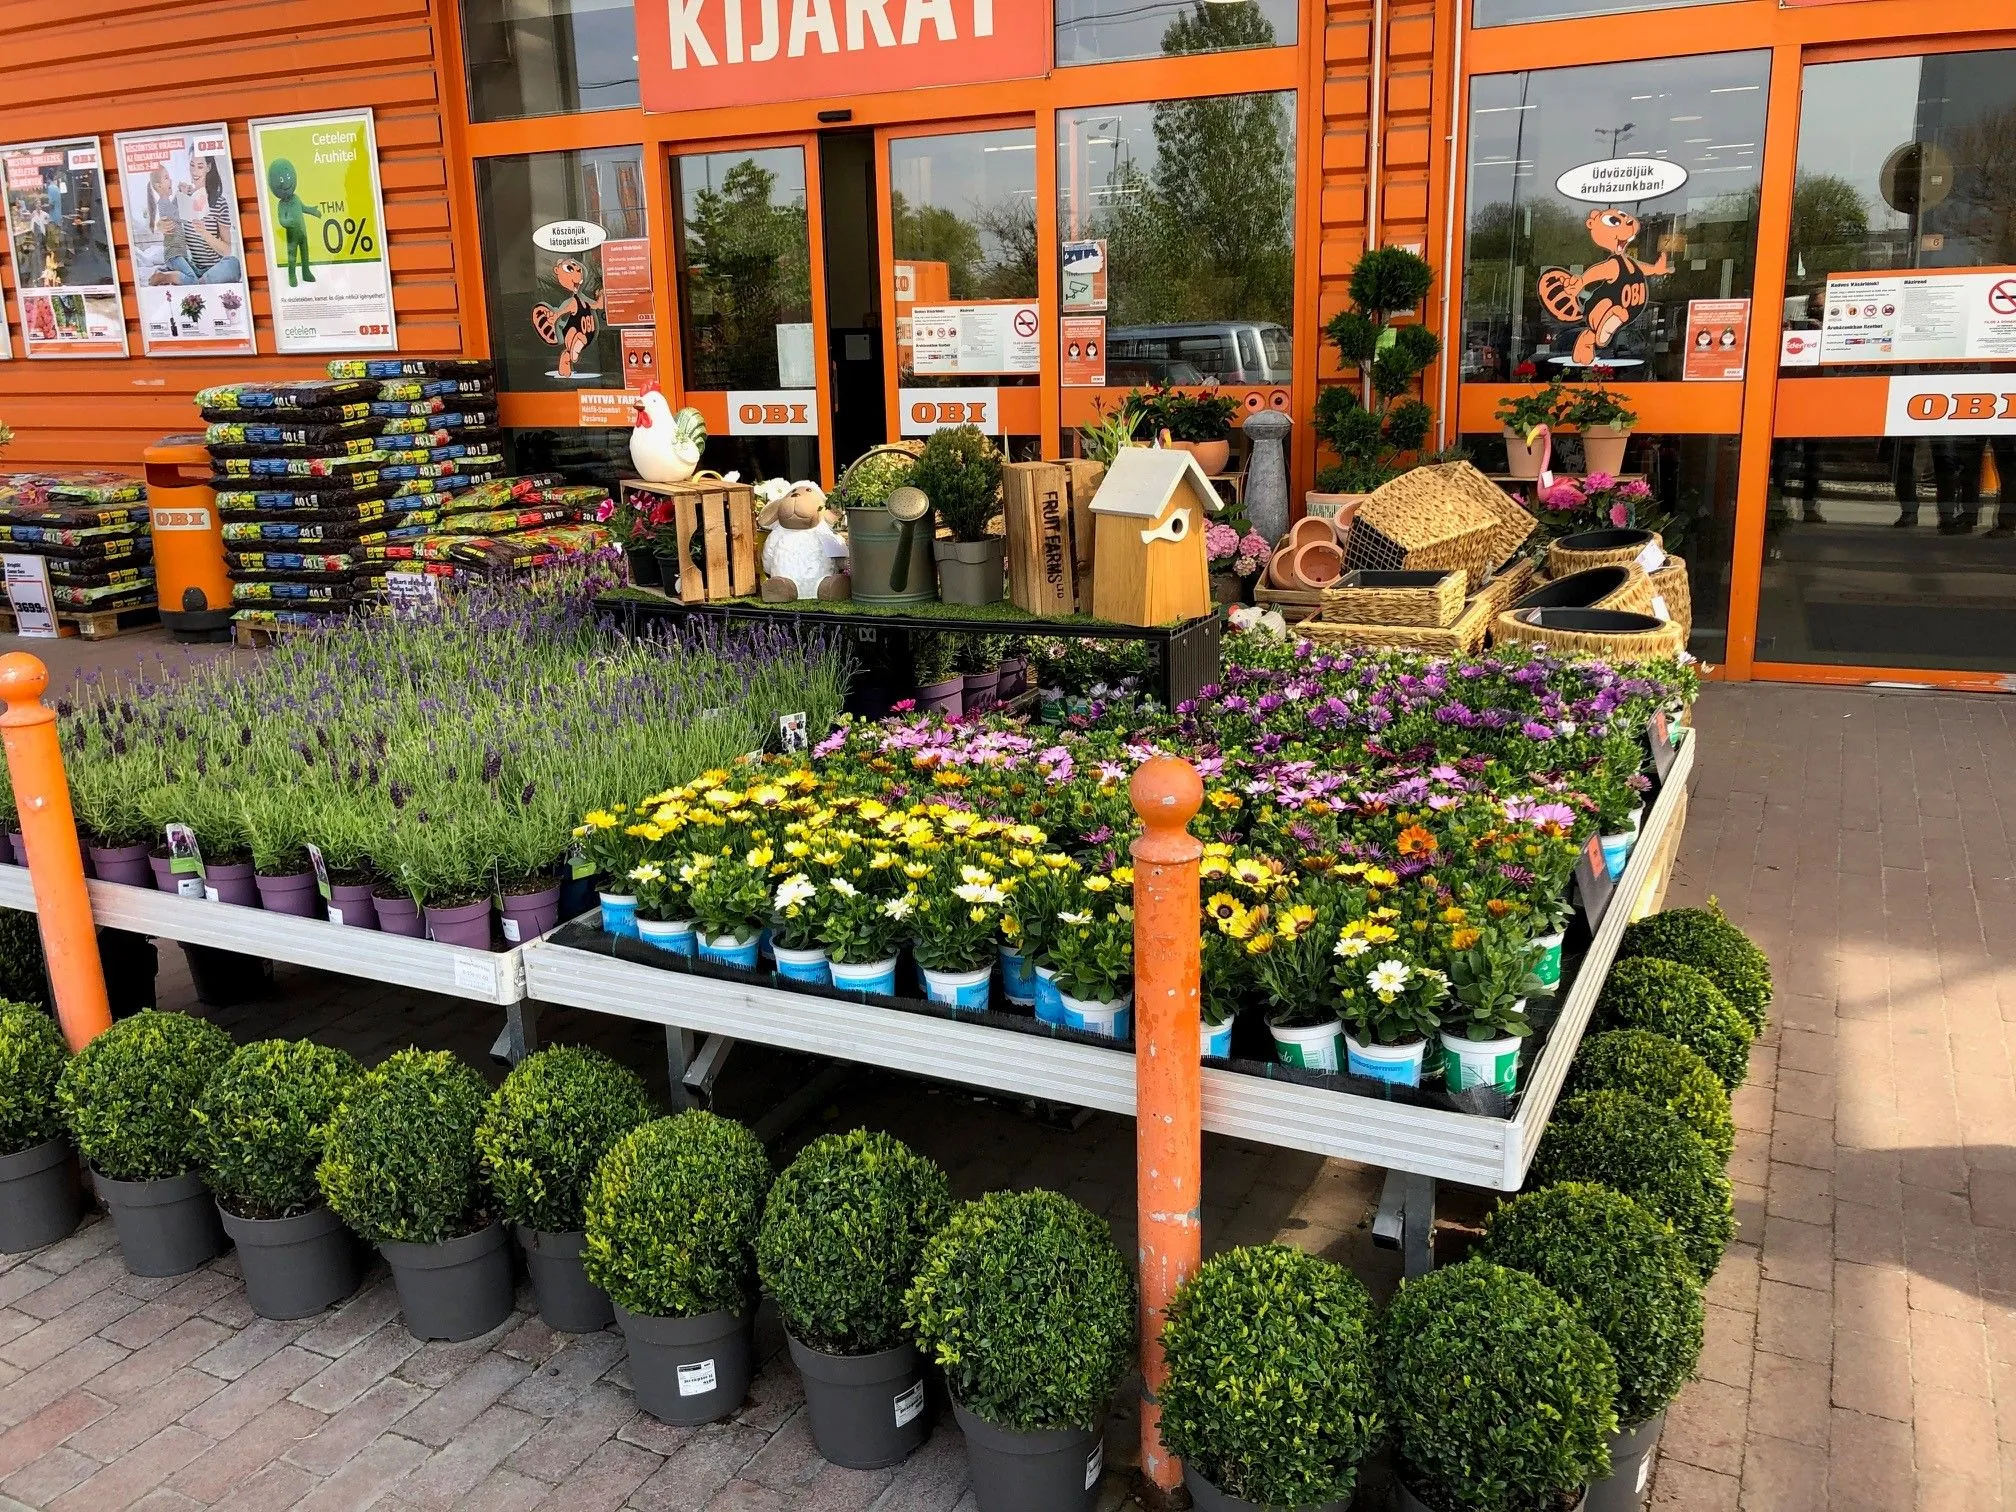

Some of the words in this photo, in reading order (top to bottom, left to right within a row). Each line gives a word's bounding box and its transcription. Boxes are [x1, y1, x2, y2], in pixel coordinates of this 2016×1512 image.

[198, 140, 225, 151] OBI
[311, 131, 358, 146] Cetelem
[72, 154, 96, 164] OBI
[313, 148, 358, 164] Áruhitel
[1592, 165, 1655, 180] Üdvözöljük
[1581, 180, 1665, 194] áruházunkban!
[320, 201, 345, 213] THM
[323, 218, 373, 255] 0%
[552, 226, 586, 236] Köszönjük
[549, 236, 590, 247] látogatását!
[1621, 282, 1646, 307] OBI
[285, 326, 317, 336] cetelem
[359, 325, 389, 335] OBI
[581, 315, 595, 335] OBI
[581, 394, 615, 404] NYITVA
[739, 404, 808, 424] OBI
[911, 402, 987, 423] OBI
[1042, 491, 1061, 532] FRUIT
[156, 512, 205, 526] OBI
[1045, 534, 1063, 584] FARMS
[1056, 583, 1065, 599] LTD
[15, 602, 42, 613] 3699
